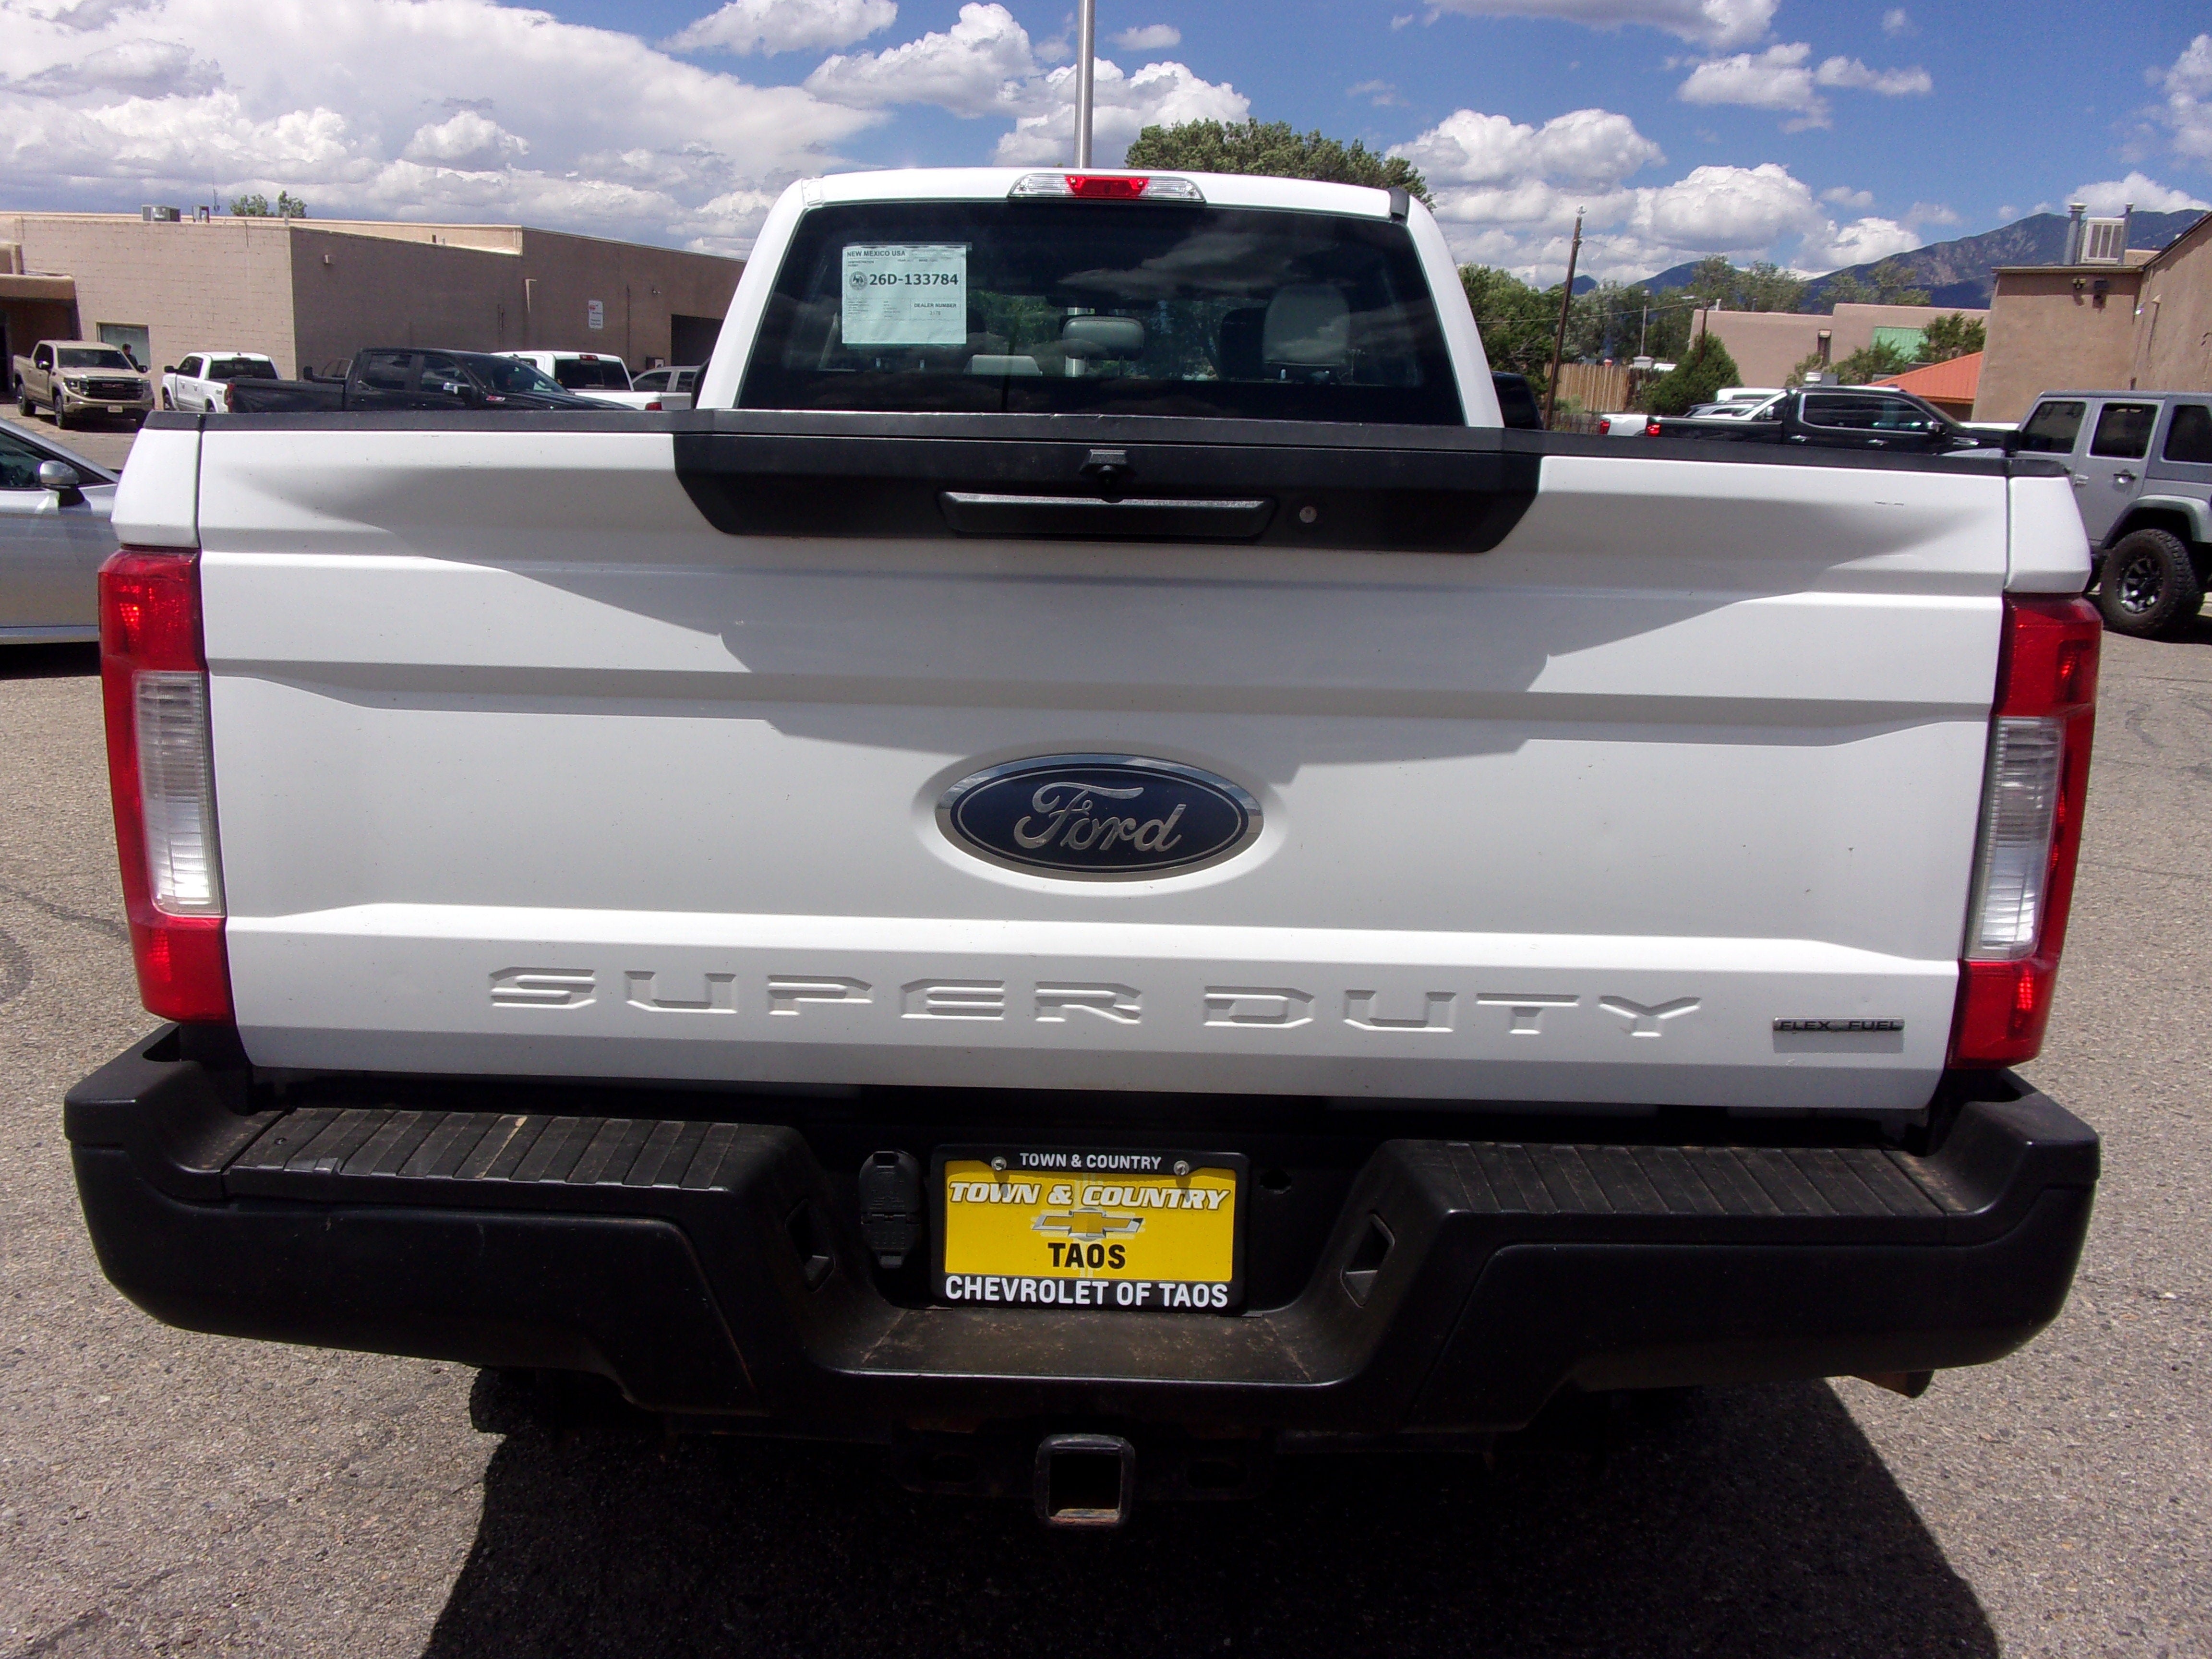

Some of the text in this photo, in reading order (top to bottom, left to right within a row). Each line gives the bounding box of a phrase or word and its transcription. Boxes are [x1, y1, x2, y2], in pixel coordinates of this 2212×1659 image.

[869, 274, 959, 285] 26D-133784
[1013, 781, 1187, 852] Ford
[490, 967, 1702, 1038] SUPER DUTY
[1780, 1021, 1900, 1030] FLEX FUEL
[1020, 1153, 1162, 1170] TOWN & COUNTRY
[949, 1182, 1231, 1210] TOWN & COUNTRY
[1048, 1242, 1126, 1269] TAOS
[946, 1276, 1228, 1308] CHEVROLET OF TAOS
